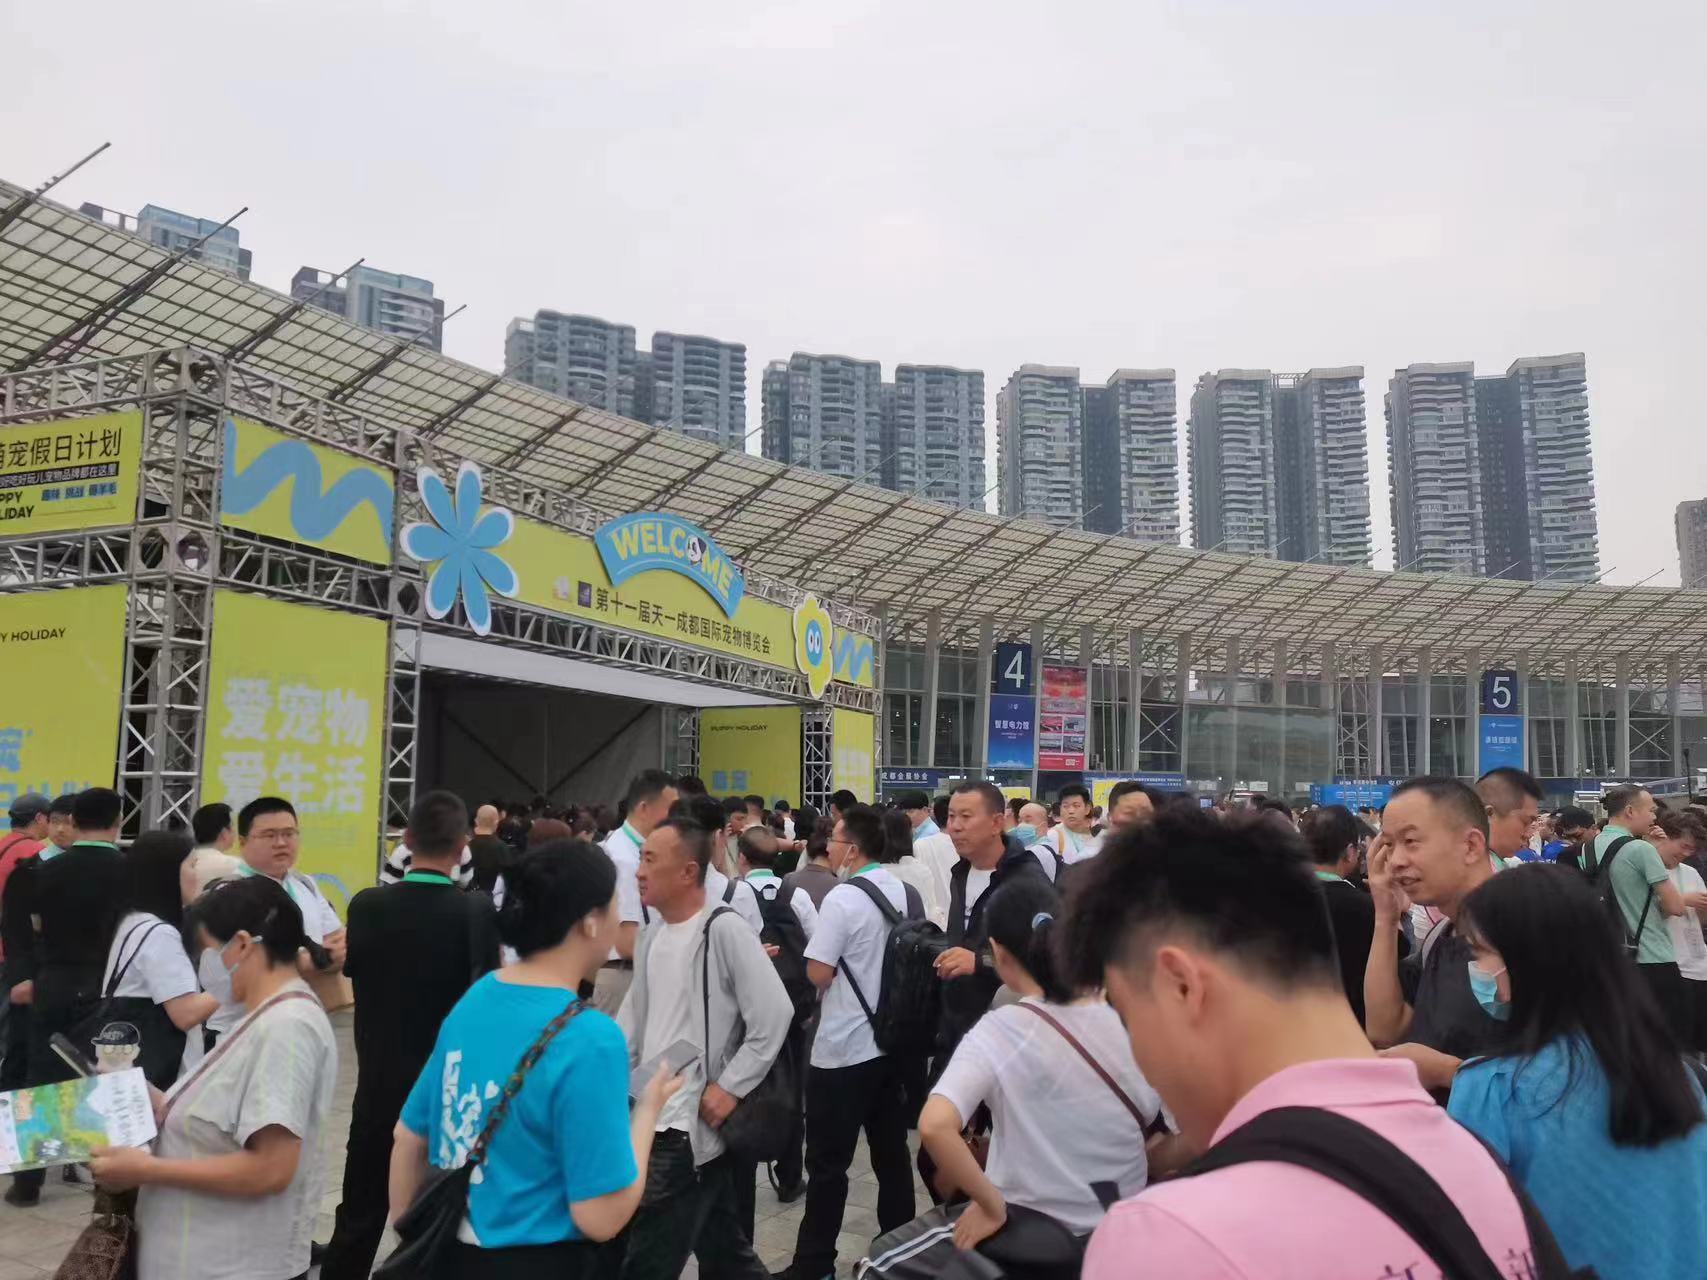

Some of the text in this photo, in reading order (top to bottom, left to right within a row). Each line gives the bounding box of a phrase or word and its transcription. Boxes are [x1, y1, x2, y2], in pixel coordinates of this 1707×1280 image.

[0, 428, 122, 469] 宠假日计划
[610, 522, 735, 601] WELCOME
[11, 627, 66, 642] HOLIDAY
[595, 586, 771, 656] 第十一届天一成都国际宠物博览会
[1004, 650, 1025, 689] 4
[221, 676, 371, 748] 爱宠物
[1492, 676, 1512, 709] 5
[736, 724, 769, 732] HOLIDAY
[218, 752, 366, 814] 爱生活
